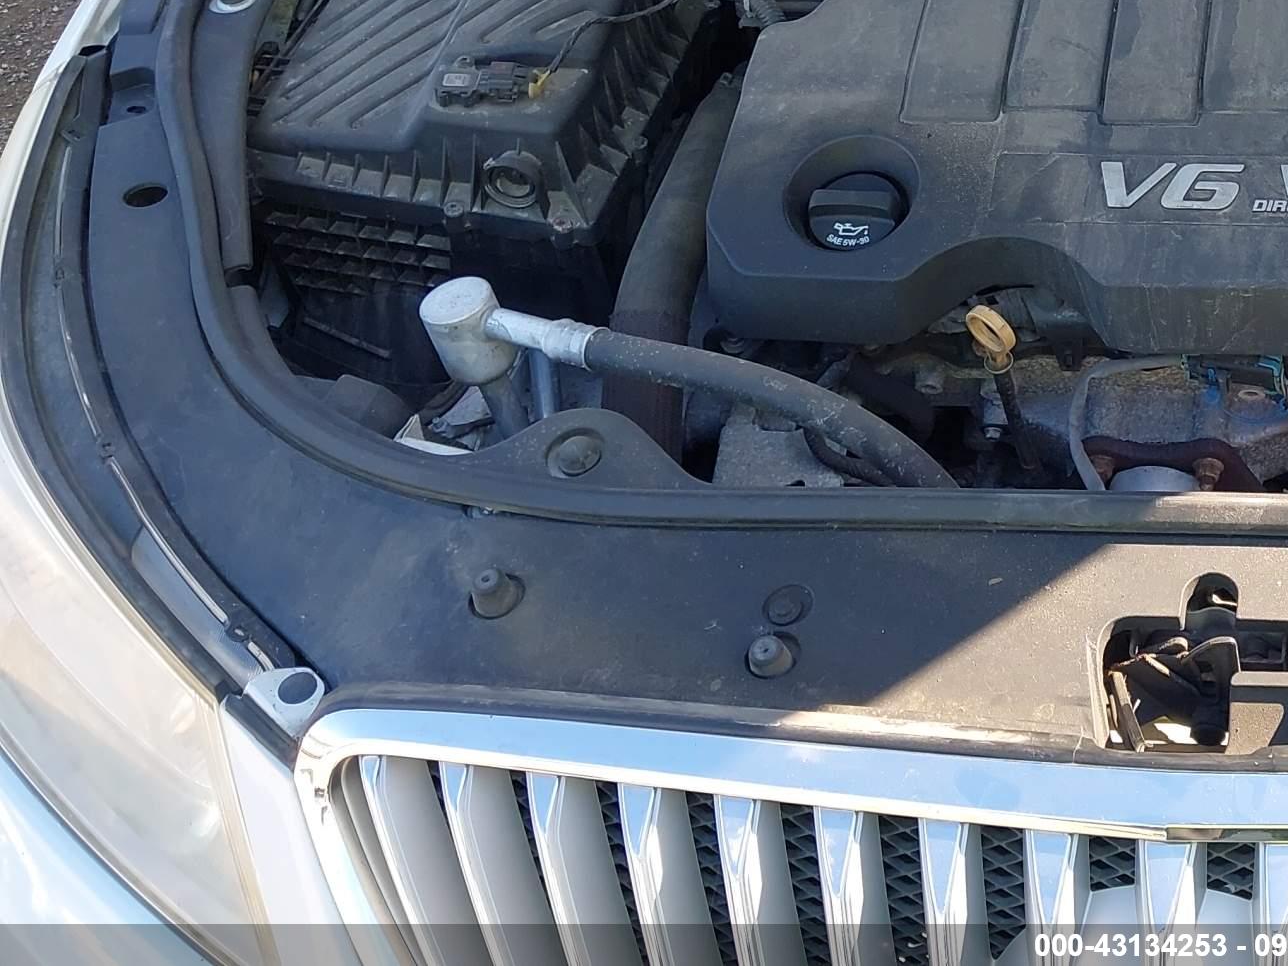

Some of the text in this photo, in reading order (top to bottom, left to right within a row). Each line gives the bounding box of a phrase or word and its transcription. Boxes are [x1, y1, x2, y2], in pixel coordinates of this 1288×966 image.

[1100, 161, 1245, 210] V6
[826, 234, 870, 247] SAE 5W-30
